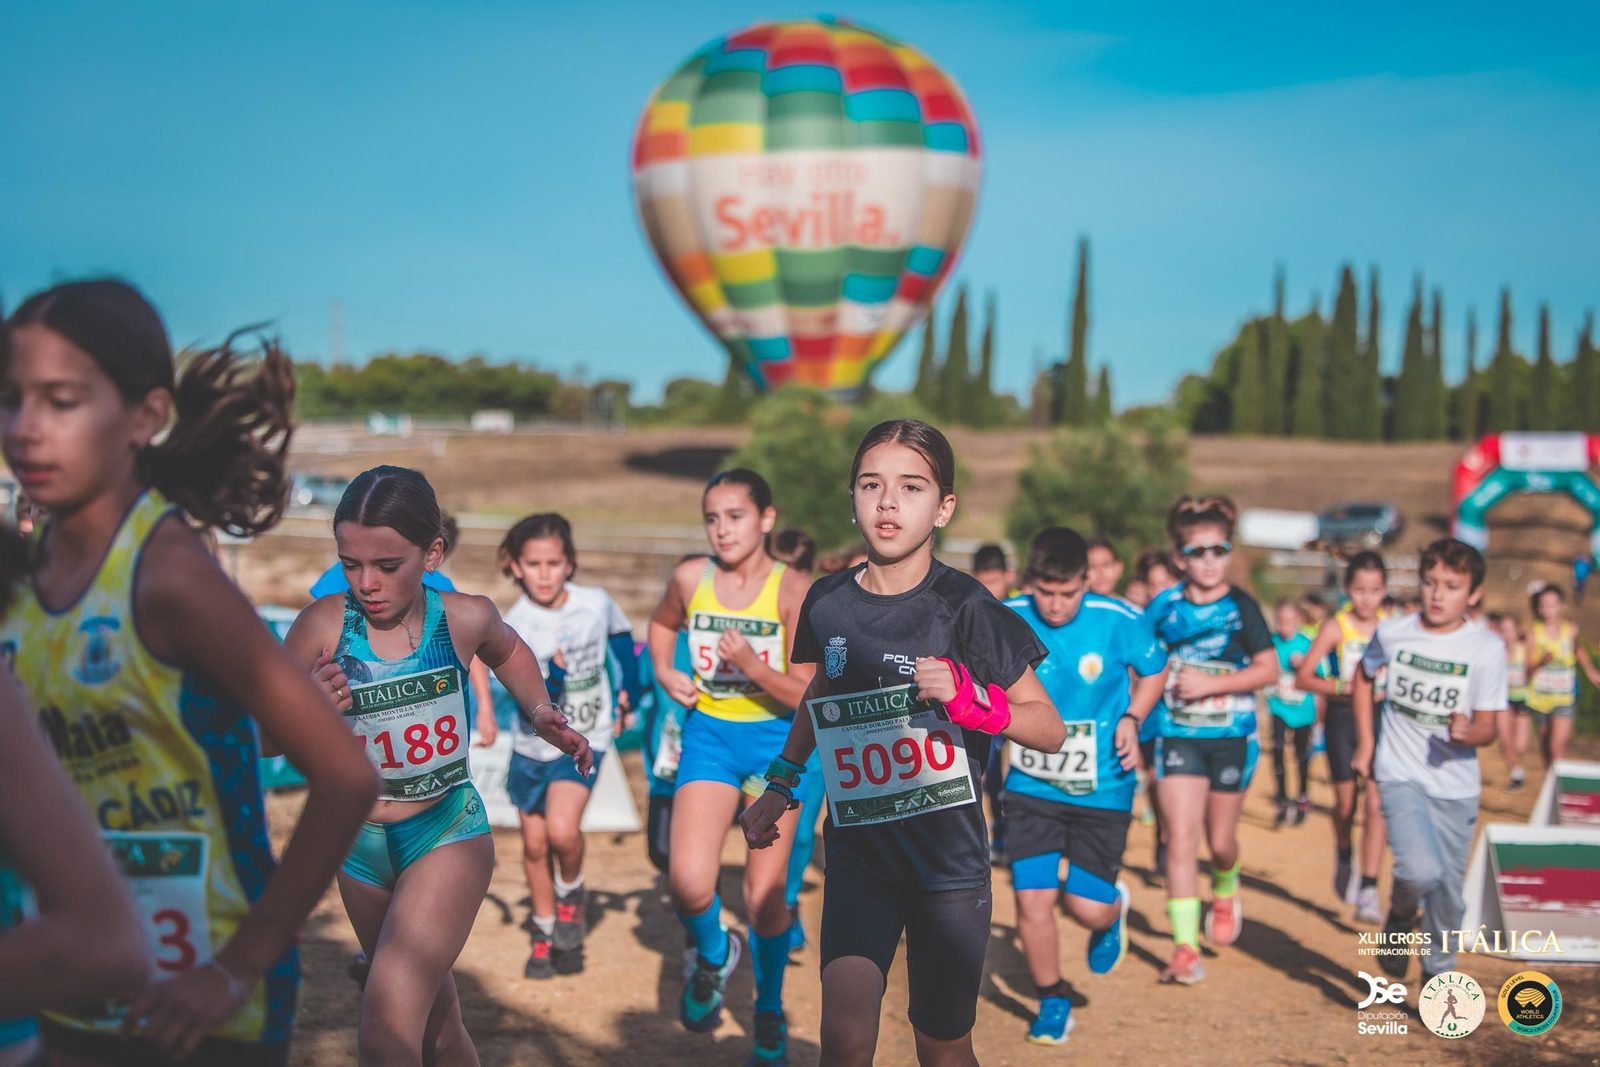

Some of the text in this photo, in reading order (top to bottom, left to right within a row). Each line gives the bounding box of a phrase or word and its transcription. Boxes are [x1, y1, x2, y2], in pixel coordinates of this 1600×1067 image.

[359, 681, 426, 705] ITÁLICA
[847, 693, 914, 716] ITÁLICA
[1394, 676, 1459, 709] 5648
[354, 700, 438, 721] CLAUDIA MONTILLA MEDINA
[842, 713, 929, 733] CANDELA DORADO PALOMERO
[866, 724, 904, 735] INDEPENDIENTE
[356, 715, 460, 769] 188
[834, 730, 956, 790] 5090
[1021, 748, 1089, 772] 6172
[97, 779, 205, 832] CÁDIZ
[152, 908, 196, 972] 3
